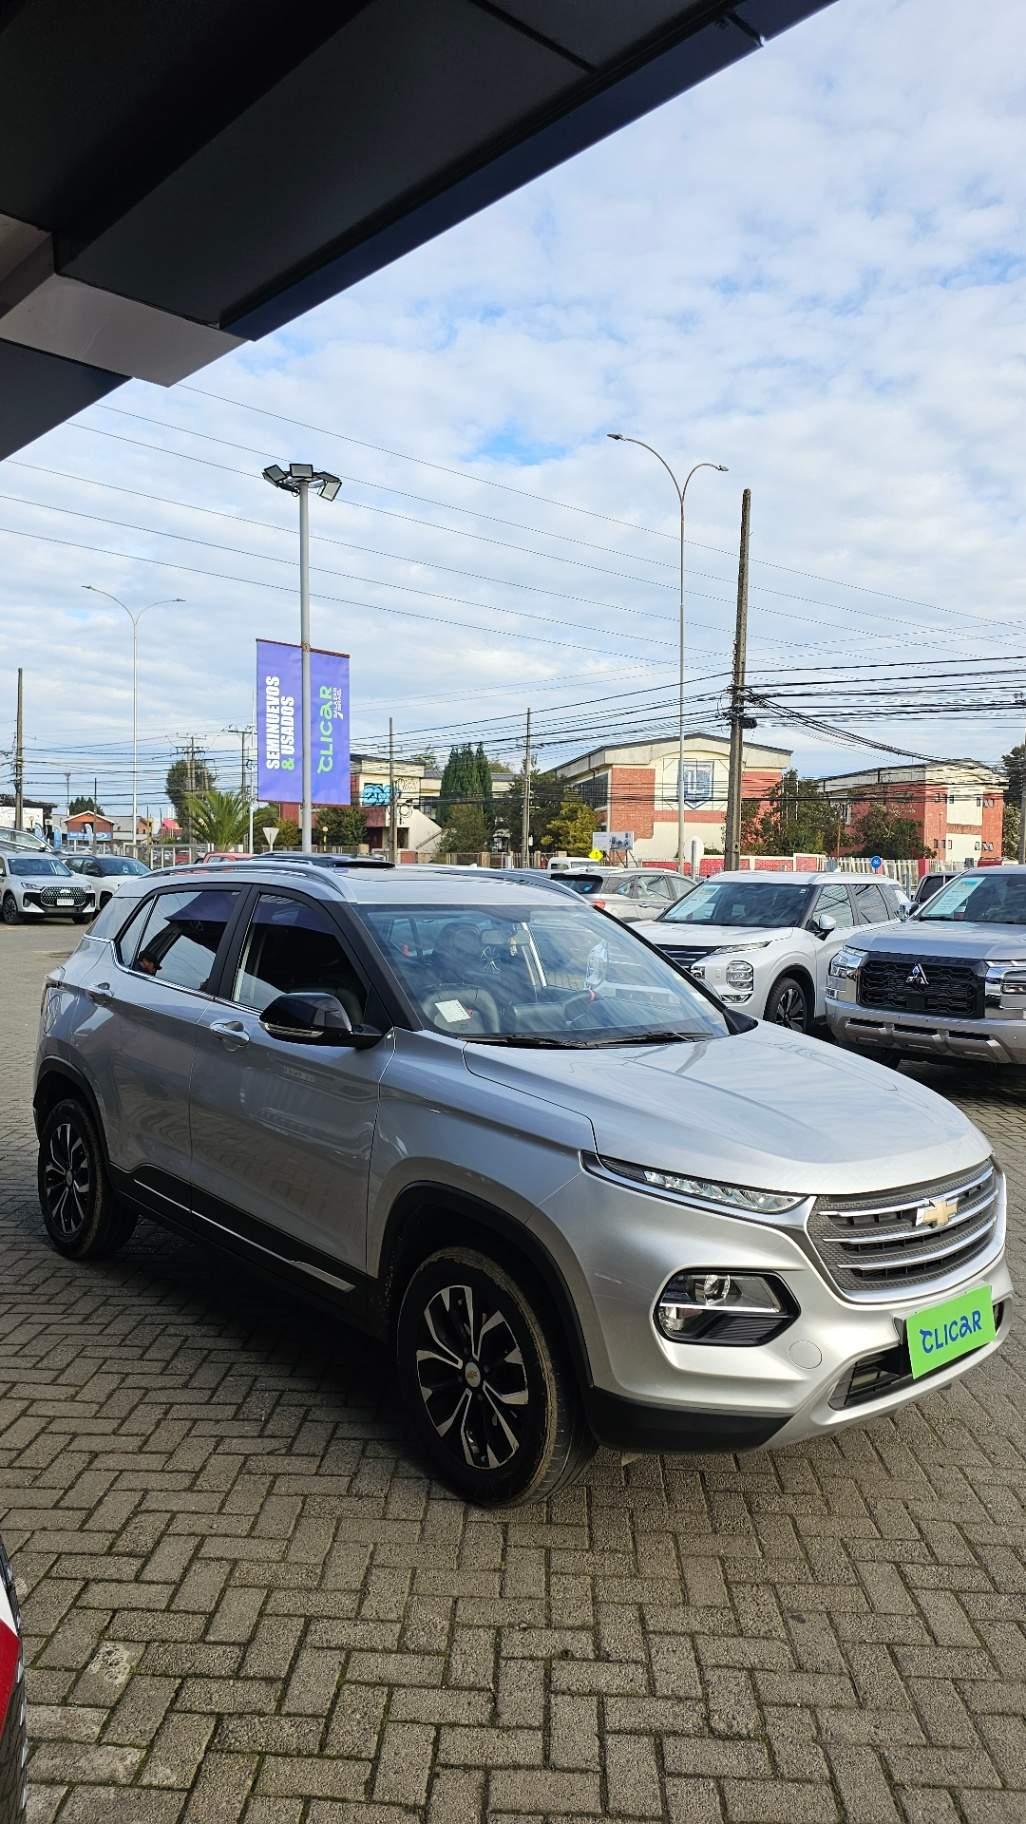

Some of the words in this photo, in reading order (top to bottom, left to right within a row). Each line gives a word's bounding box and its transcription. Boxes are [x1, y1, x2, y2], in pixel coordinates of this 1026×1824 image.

[266, 675, 280, 770] SEMINUEVOS
[281, 696, 295, 756] USADOS
[281, 757, 295, 771] &
